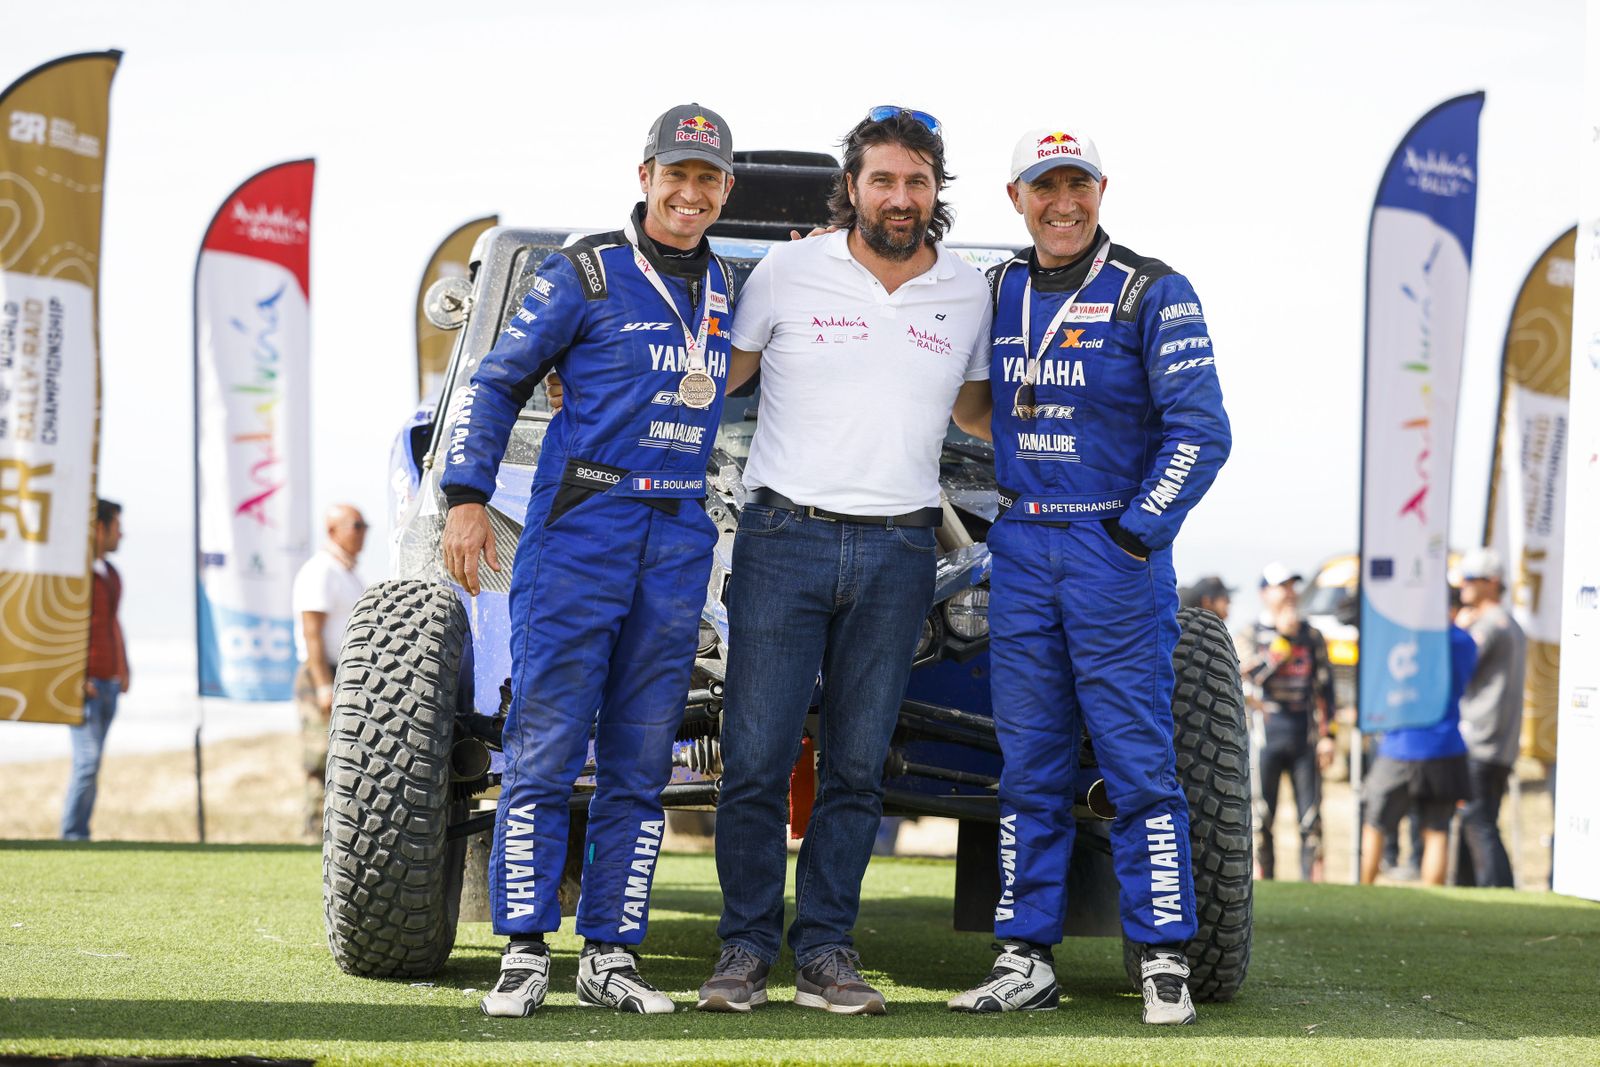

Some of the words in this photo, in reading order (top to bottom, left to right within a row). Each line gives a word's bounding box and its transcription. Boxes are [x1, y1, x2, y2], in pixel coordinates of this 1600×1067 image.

[675, 130, 699, 141] Red
[700, 131, 720, 149] Bull
[1037, 146, 1060, 159] Red
[1061, 145, 1082, 156] Bull
[579, 251, 602, 292] sparco
[1122, 275, 1147, 312] sparco
[1080, 305, 1109, 314] YAMAHA
[1159, 303, 1202, 321] YAMALUBE
[811, 316, 869, 329] Andalucía
[907, 324, 952, 351] Andalucía
[916, 340, 945, 355] RALLY
[1160, 336, 1210, 356] GYTR
[649, 344, 727, 378] YAMHA
[576, 467, 620, 483] sparco
[1141, 443, 1200, 516] YAMAHA
[1042, 500, 1124, 513] S.PETERHANSEL
[505, 804, 536, 920] YAMAHA
[1146, 814, 1182, 926] YAMAHA
[618, 820, 664, 933] YAMAHA
[1005, 981, 1034, 1001] ASTARS
